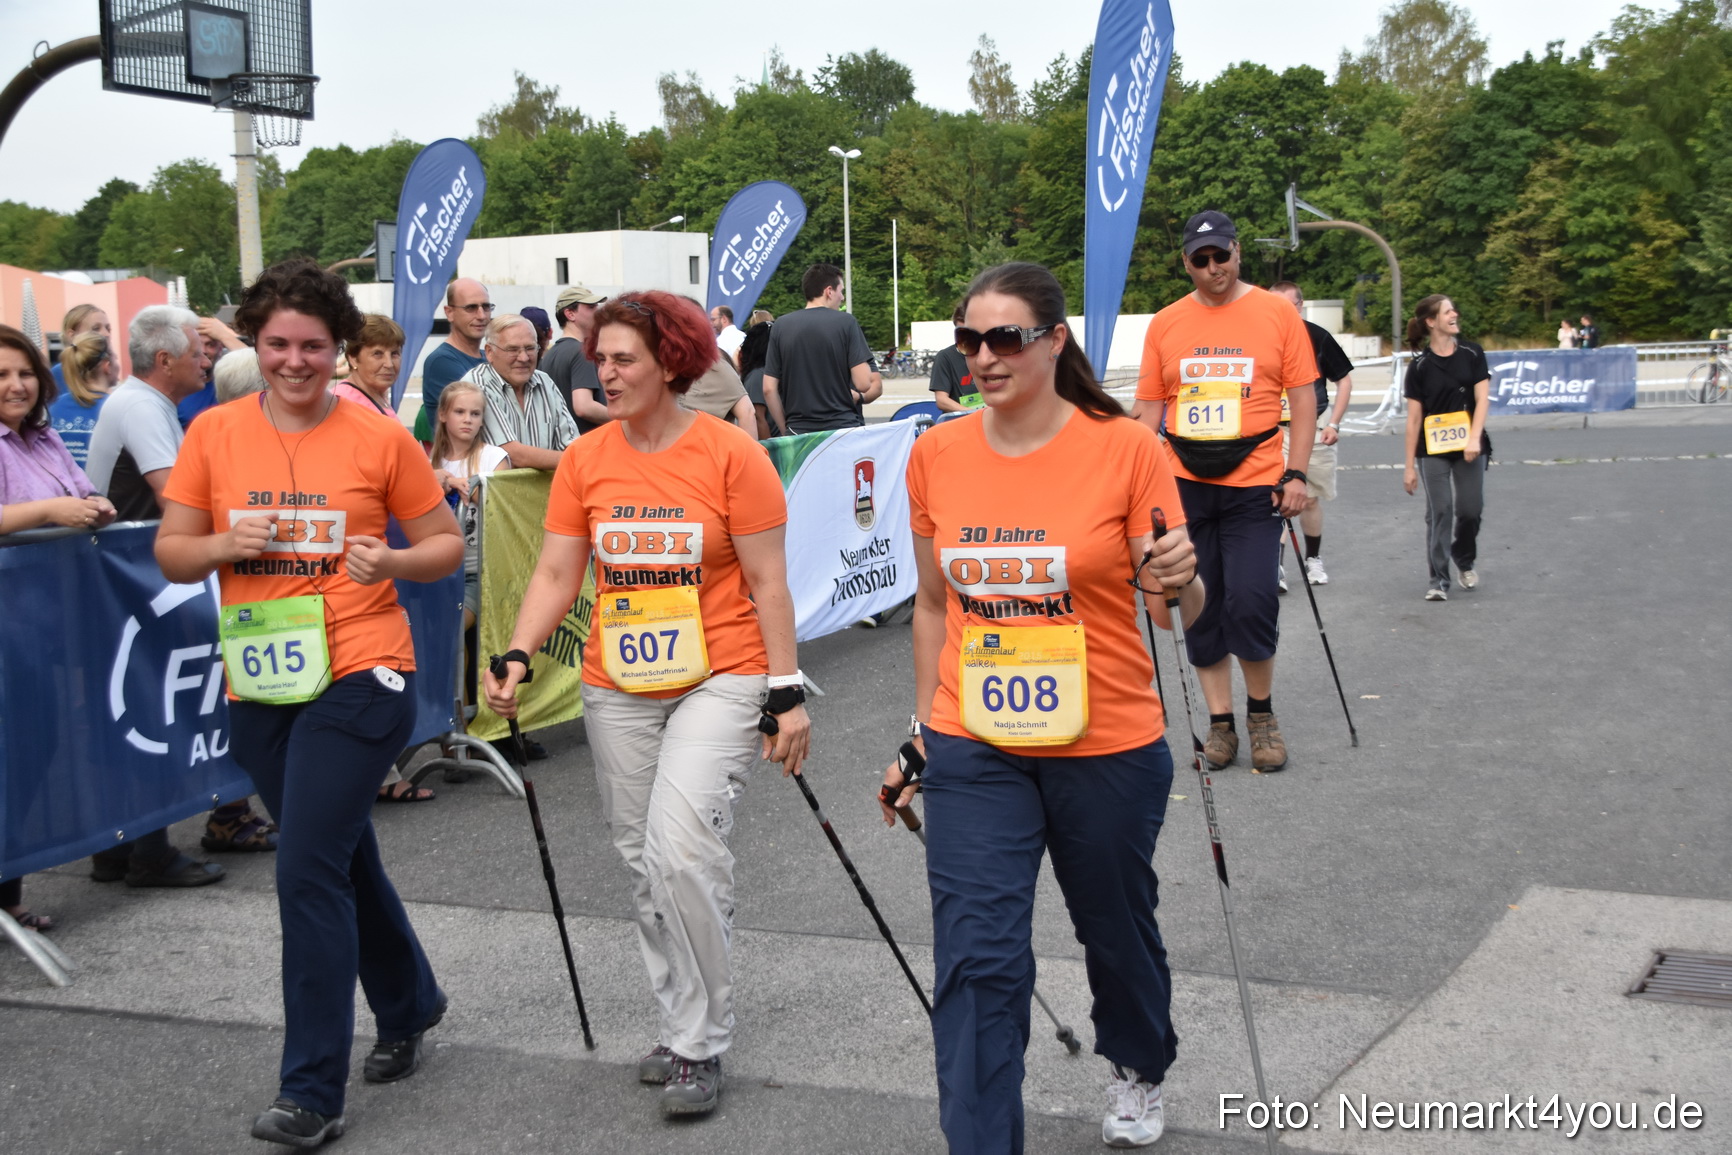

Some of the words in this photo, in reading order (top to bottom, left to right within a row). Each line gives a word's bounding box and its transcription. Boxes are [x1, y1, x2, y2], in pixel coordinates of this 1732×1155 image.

[1110, 2, 1156, 181] Fischer
[1130, 36, 1161, 179] AUTOMOBILE
[418, 165, 468, 267] Fischer
[437, 187, 474, 267] AUTOMOBILE
[731, 199, 785, 282] Fischer
[750, 215, 791, 281] AUTOMOBILE
[1193, 346, 1210, 356] 30
[1213, 346, 1243, 356] Jahre
[1185, 362, 1248, 378] OBI
[1497, 375, 1596, 396] Fischer
[1506, 394, 1588, 406] AUTOMOBILE
[1188, 404, 1224, 425] 611
[1431, 426, 1467, 443] 1230
[247, 490, 274, 506] 30
[278, 490, 328, 506] Jahre
[611, 505, 636, 519] 30
[639, 505, 685, 519] Jahre
[272, 519, 337, 544] BI
[958, 526, 988, 543] 30
[992, 526, 1046, 543] Jahre
[602, 530, 694, 555] OBI
[233, 556, 341, 577] Neumarkt
[603, 565, 703, 587] Neumarkt
[949, 557, 1055, 586] OBI
[611, 607, 644, 618] firmenlauf
[958, 591, 1074, 619] Neumarkt
[619, 628, 680, 665] 607
[975, 646, 1017, 656] firmenlauf
[242, 639, 306, 678] 615
[621, 670, 648, 679] Michaela
[648, 667, 688, 677] Schaffrinski
[257, 682, 282, 691] Manuela
[982, 674, 1060, 713] 608
[993, 721, 1016, 730] Nadja
